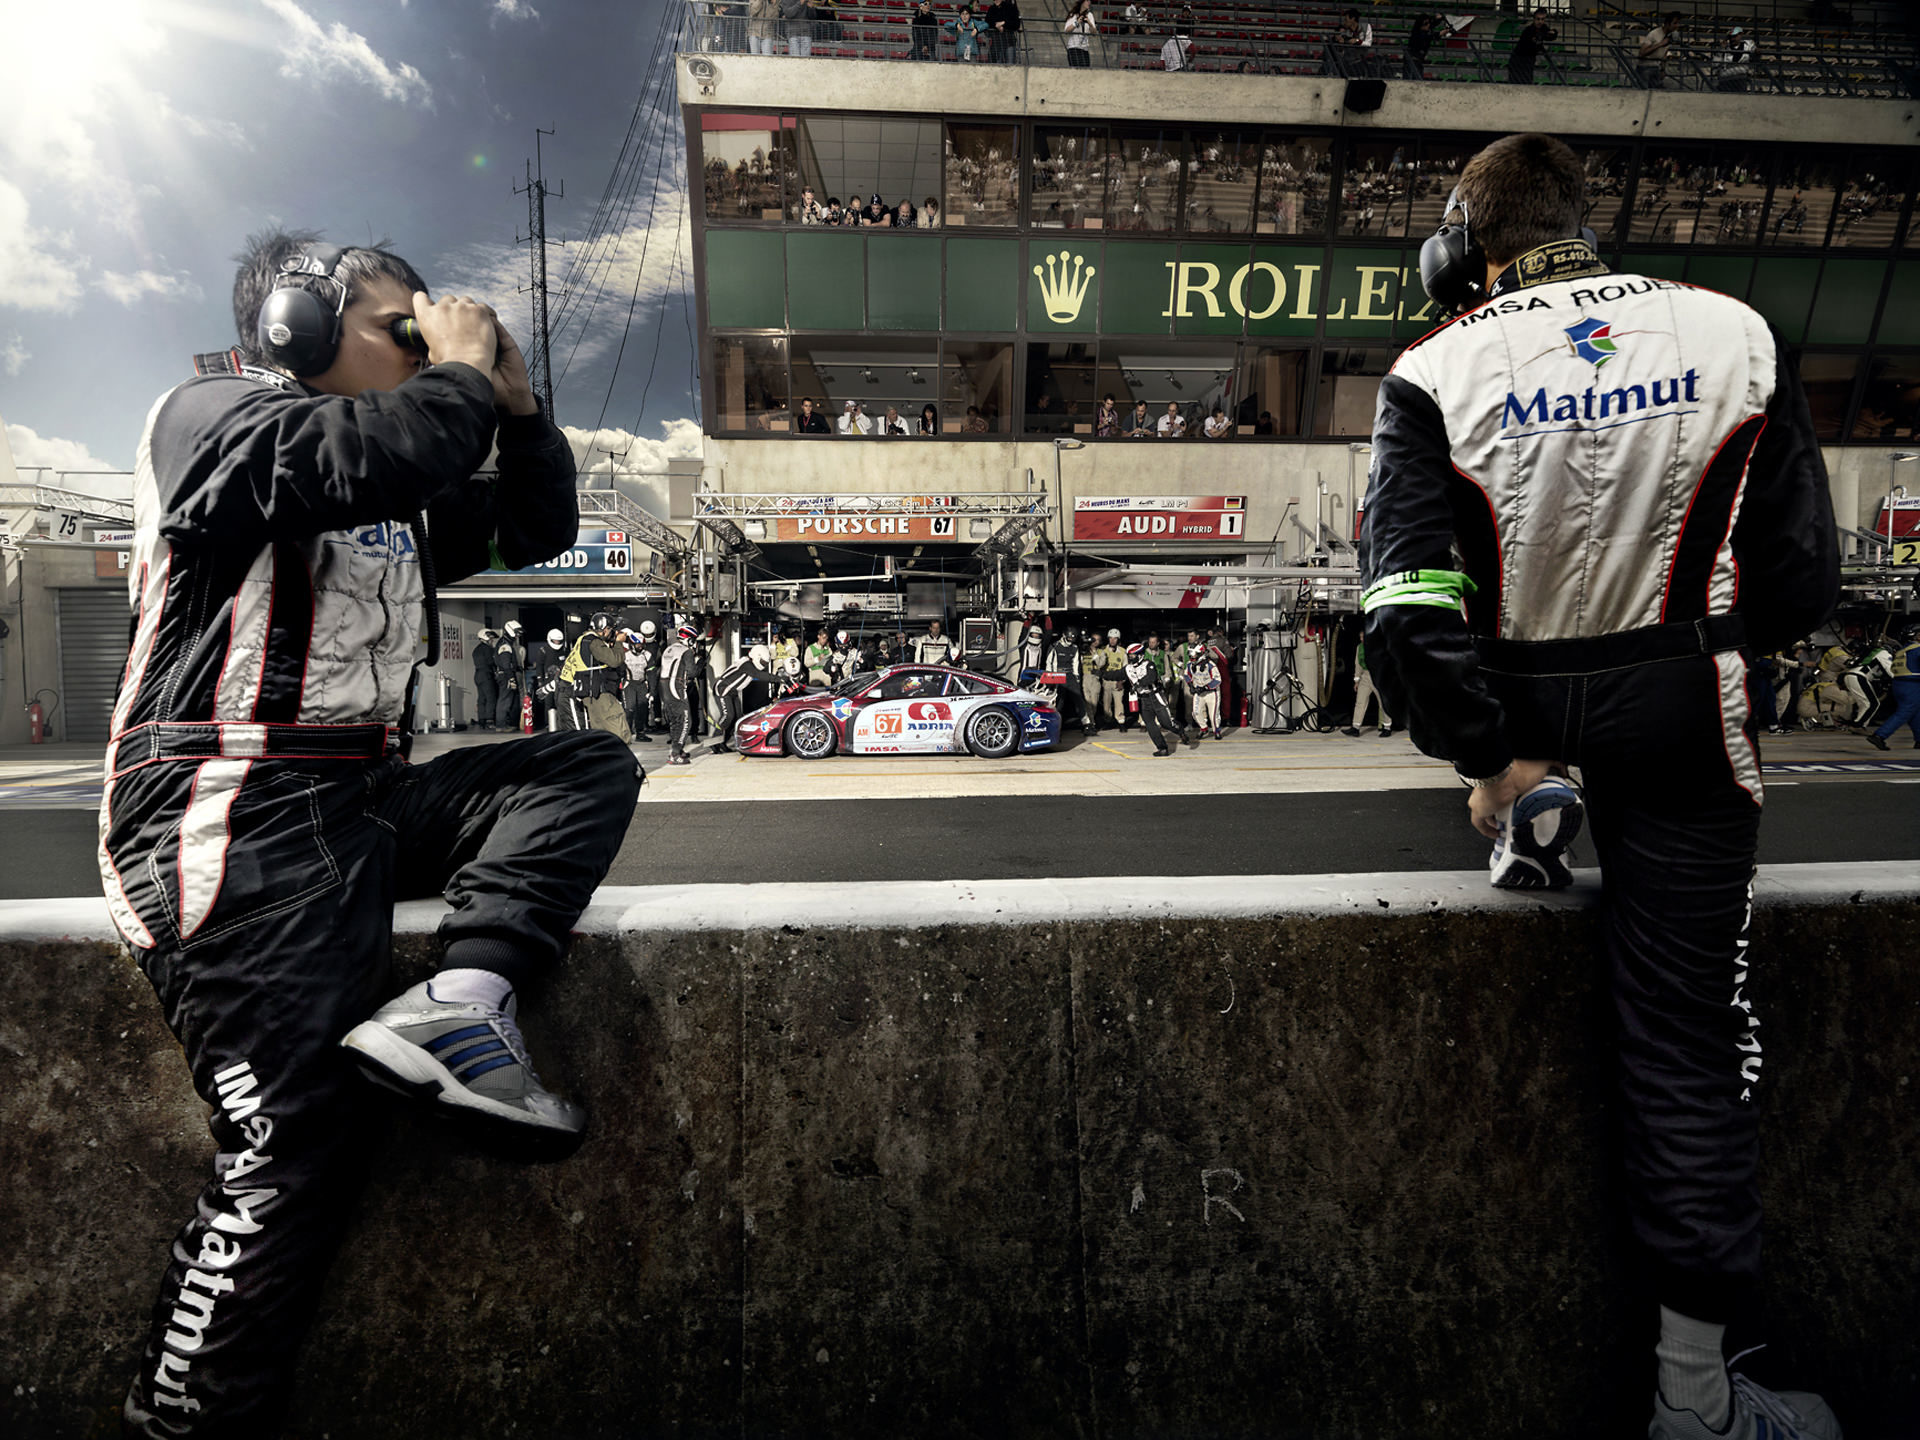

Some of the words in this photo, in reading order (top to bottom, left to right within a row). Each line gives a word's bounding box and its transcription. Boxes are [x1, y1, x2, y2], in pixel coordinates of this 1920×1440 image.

[1460, 296, 1553, 327] IMSA
[1501, 368, 1700, 430] Matmut
[1078, 500, 1091, 509] 24
[59, 513, 78, 536] 75
[797, 517, 911, 535] PORSCHE
[933, 517, 952, 534] 67
[1117, 515, 1177, 534] AUDI
[1182, 525, 1213, 534] HYBRID
[1228, 516, 1236, 533] 1
[98, 533, 113, 543] 24
[534, 550, 589, 569] UDD
[607, 549, 627, 568] 40
[1901, 544, 1918, 563] 2
[1006, 580, 1017, 590] 67
[857, 728, 869, 737] AM
[875, 715, 902, 733] 67
[907, 722, 955, 731] ADRIA
[213, 1060, 274, 1182] IMSA
[1200, 1169, 1245, 1226] R
[154, 1186, 280, 1414] Matmut
